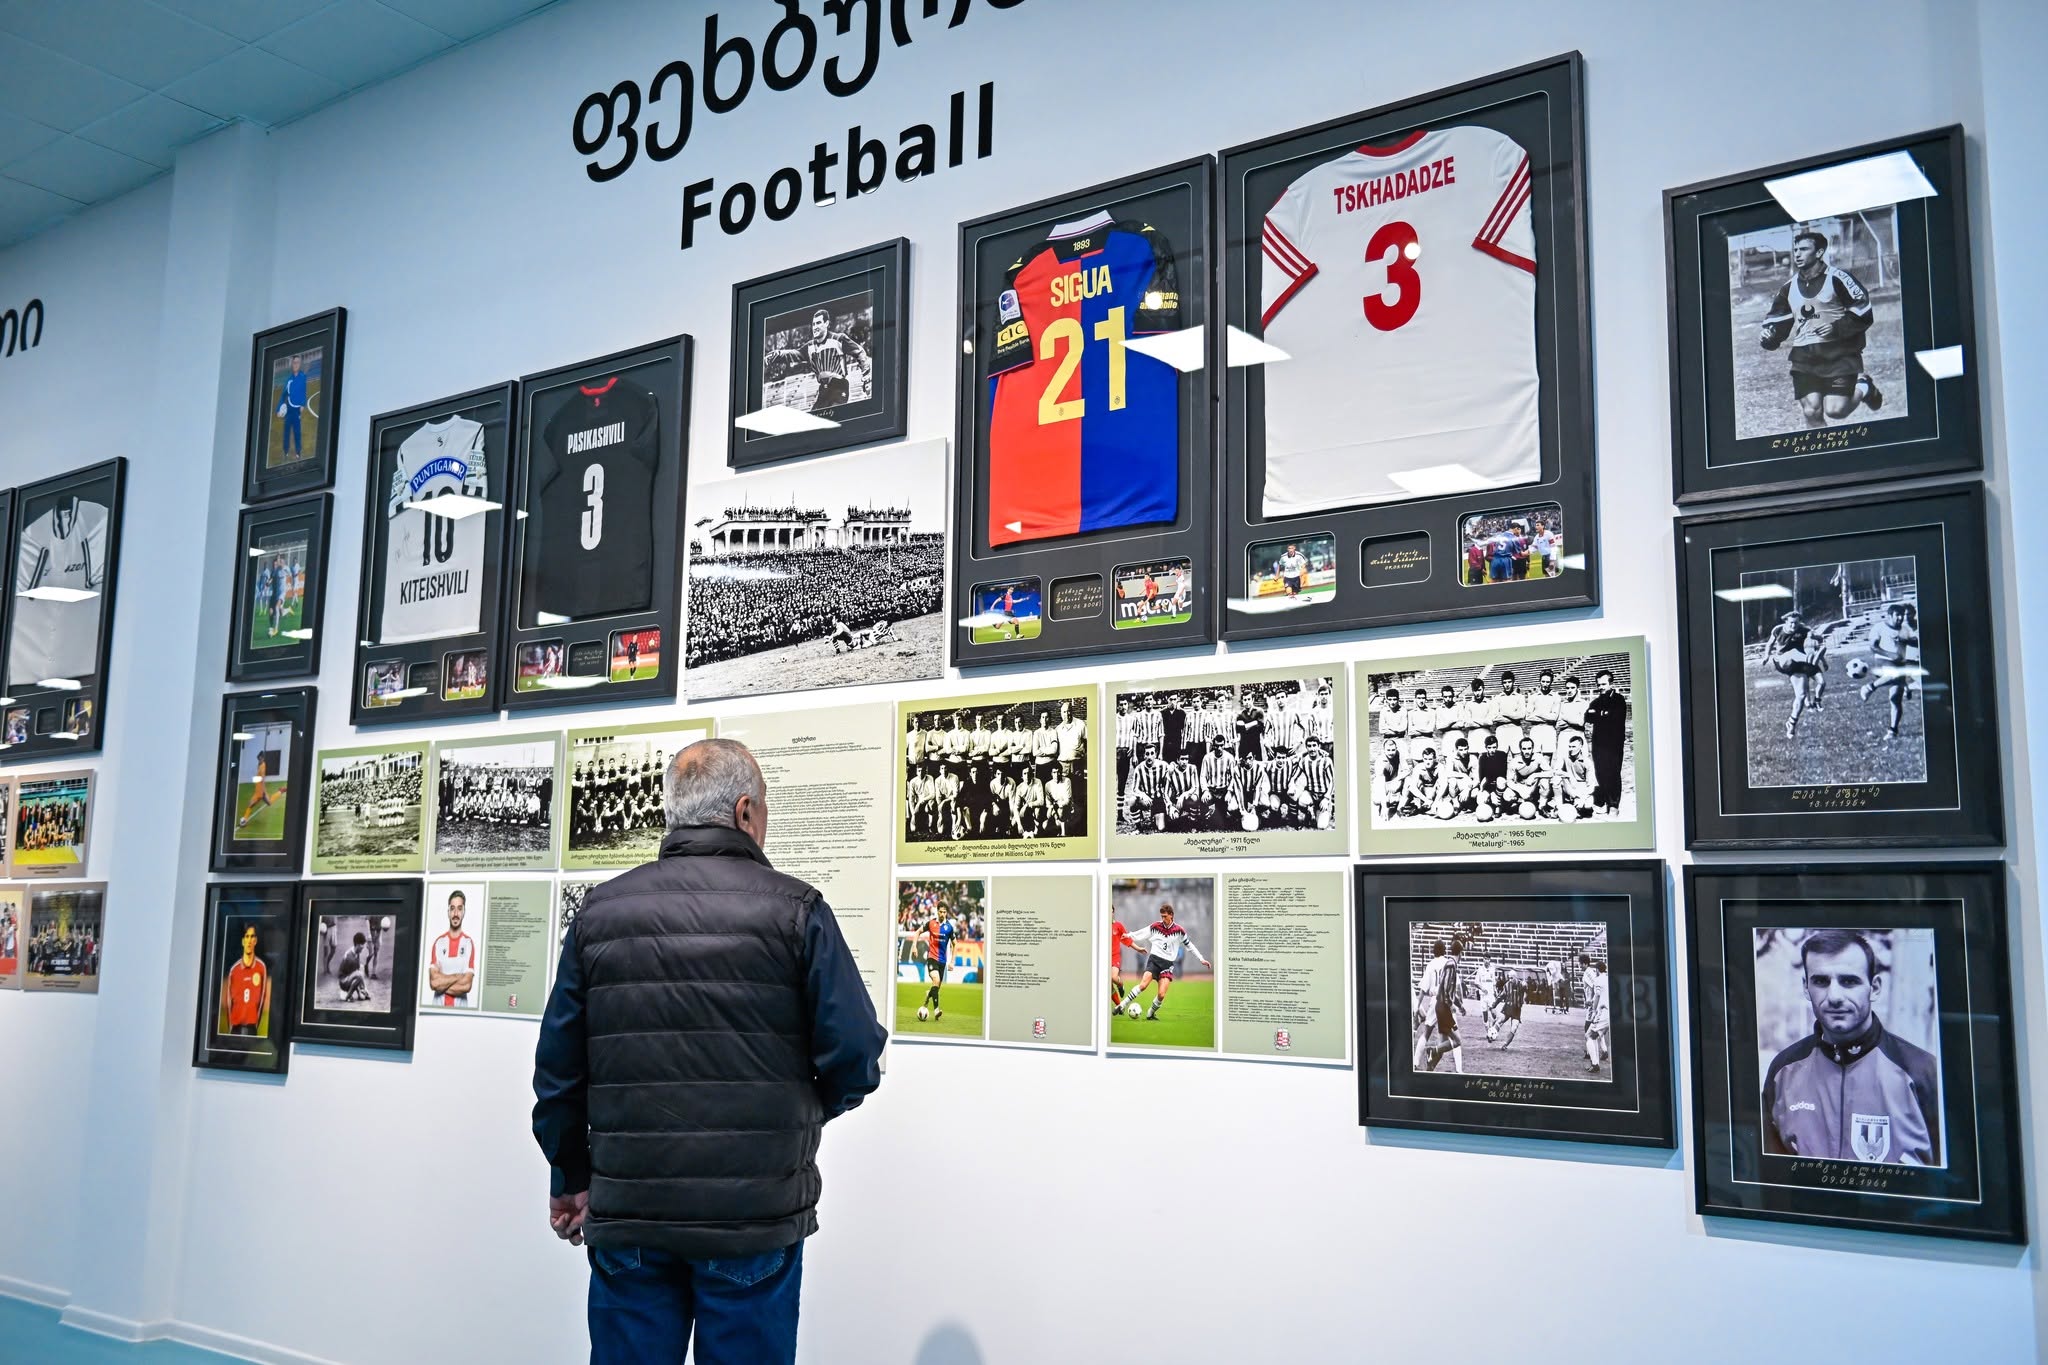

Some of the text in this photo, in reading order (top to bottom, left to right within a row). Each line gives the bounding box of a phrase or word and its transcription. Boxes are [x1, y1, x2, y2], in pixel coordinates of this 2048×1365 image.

[572, 0, 1026, 182] ფეხბუ
[681, 82, 993, 249] Football
[1334, 156, 1455, 214] TSKHADADZE
[1050, 265, 1113, 307] SIGUA
[1363, 221, 1421, 331] 3
[1001, 324, 1024, 342] CIC
[1038, 305, 1126, 425] 21
[567, 421, 625, 455] PASIKASHVILI
[413, 459, 466, 488] PUNTIGAMR
[421, 486, 455, 567] 10
[580, 463, 605, 551] 3
[400, 568, 468, 605] KITEISHVILI
[1526, 830, 1547, 838] წელი
[1789, 1101, 1816, 1112] adidas
